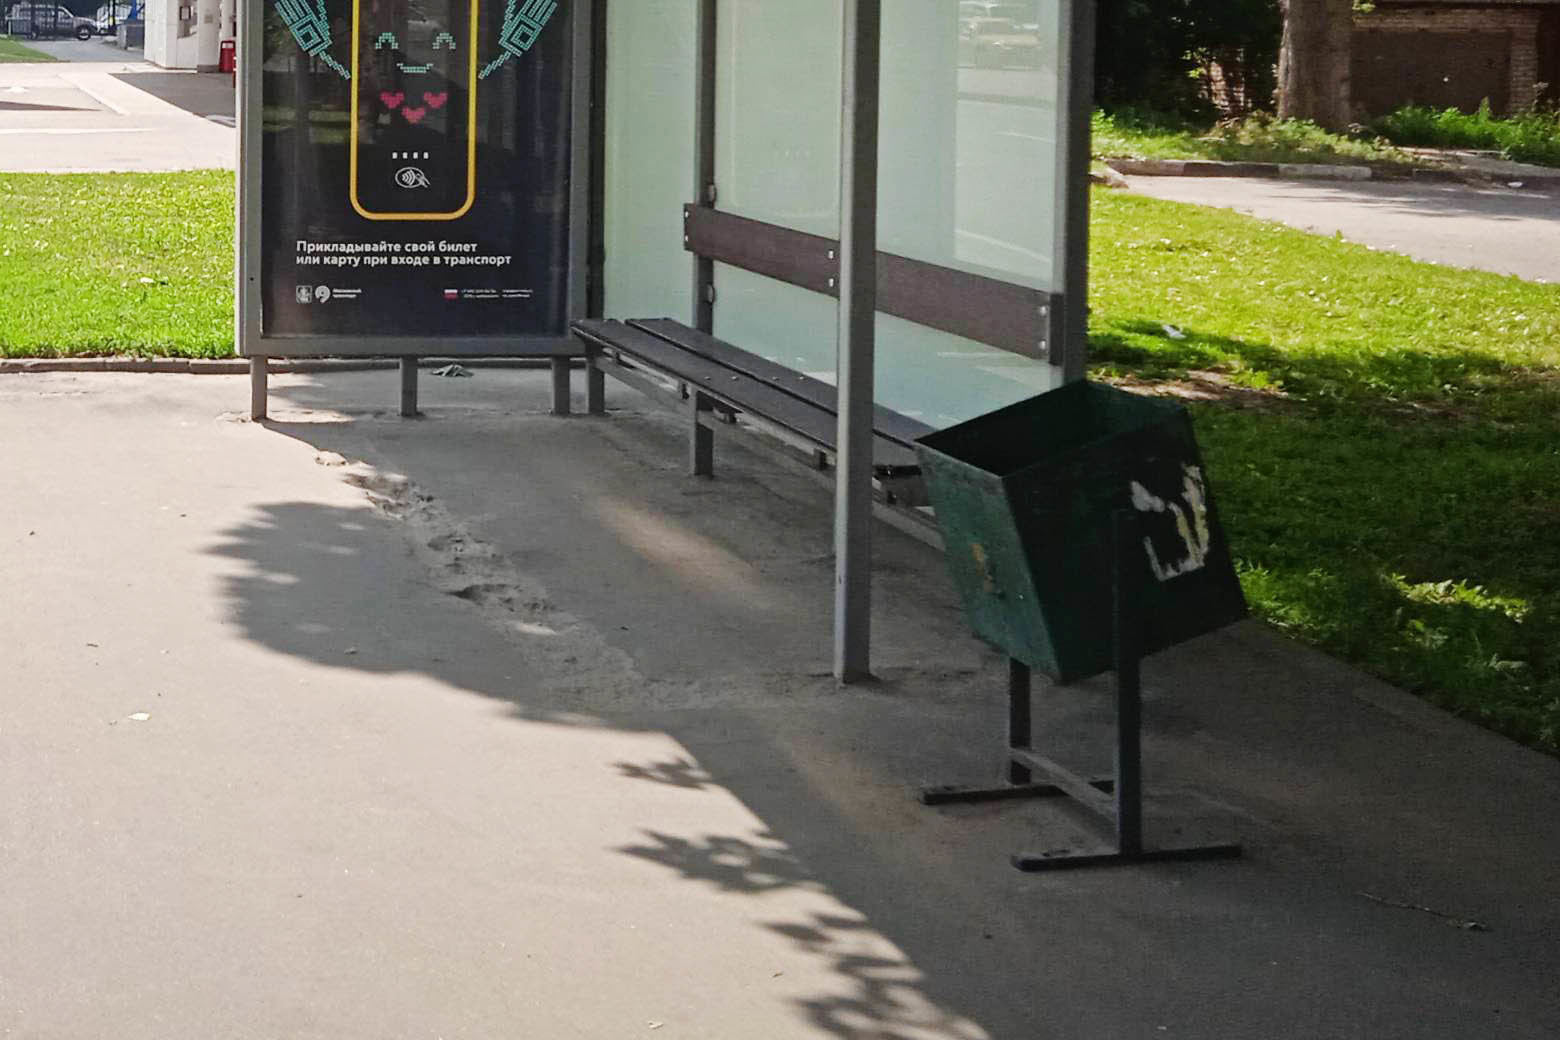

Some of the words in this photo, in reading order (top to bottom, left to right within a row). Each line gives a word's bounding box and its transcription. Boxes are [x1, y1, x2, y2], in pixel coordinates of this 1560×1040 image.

[296, 240, 401, 253] Прикладывайте
[404, 241, 436, 252] свой
[439, 241, 478, 252] билет
[296, 255, 321, 265] или
[323, 256, 361, 267] карту
[363, 256, 389, 266] при
[391, 256, 430, 266] входе
[433, 256, 441, 265] в
[444, 256, 512, 266] транспорт
